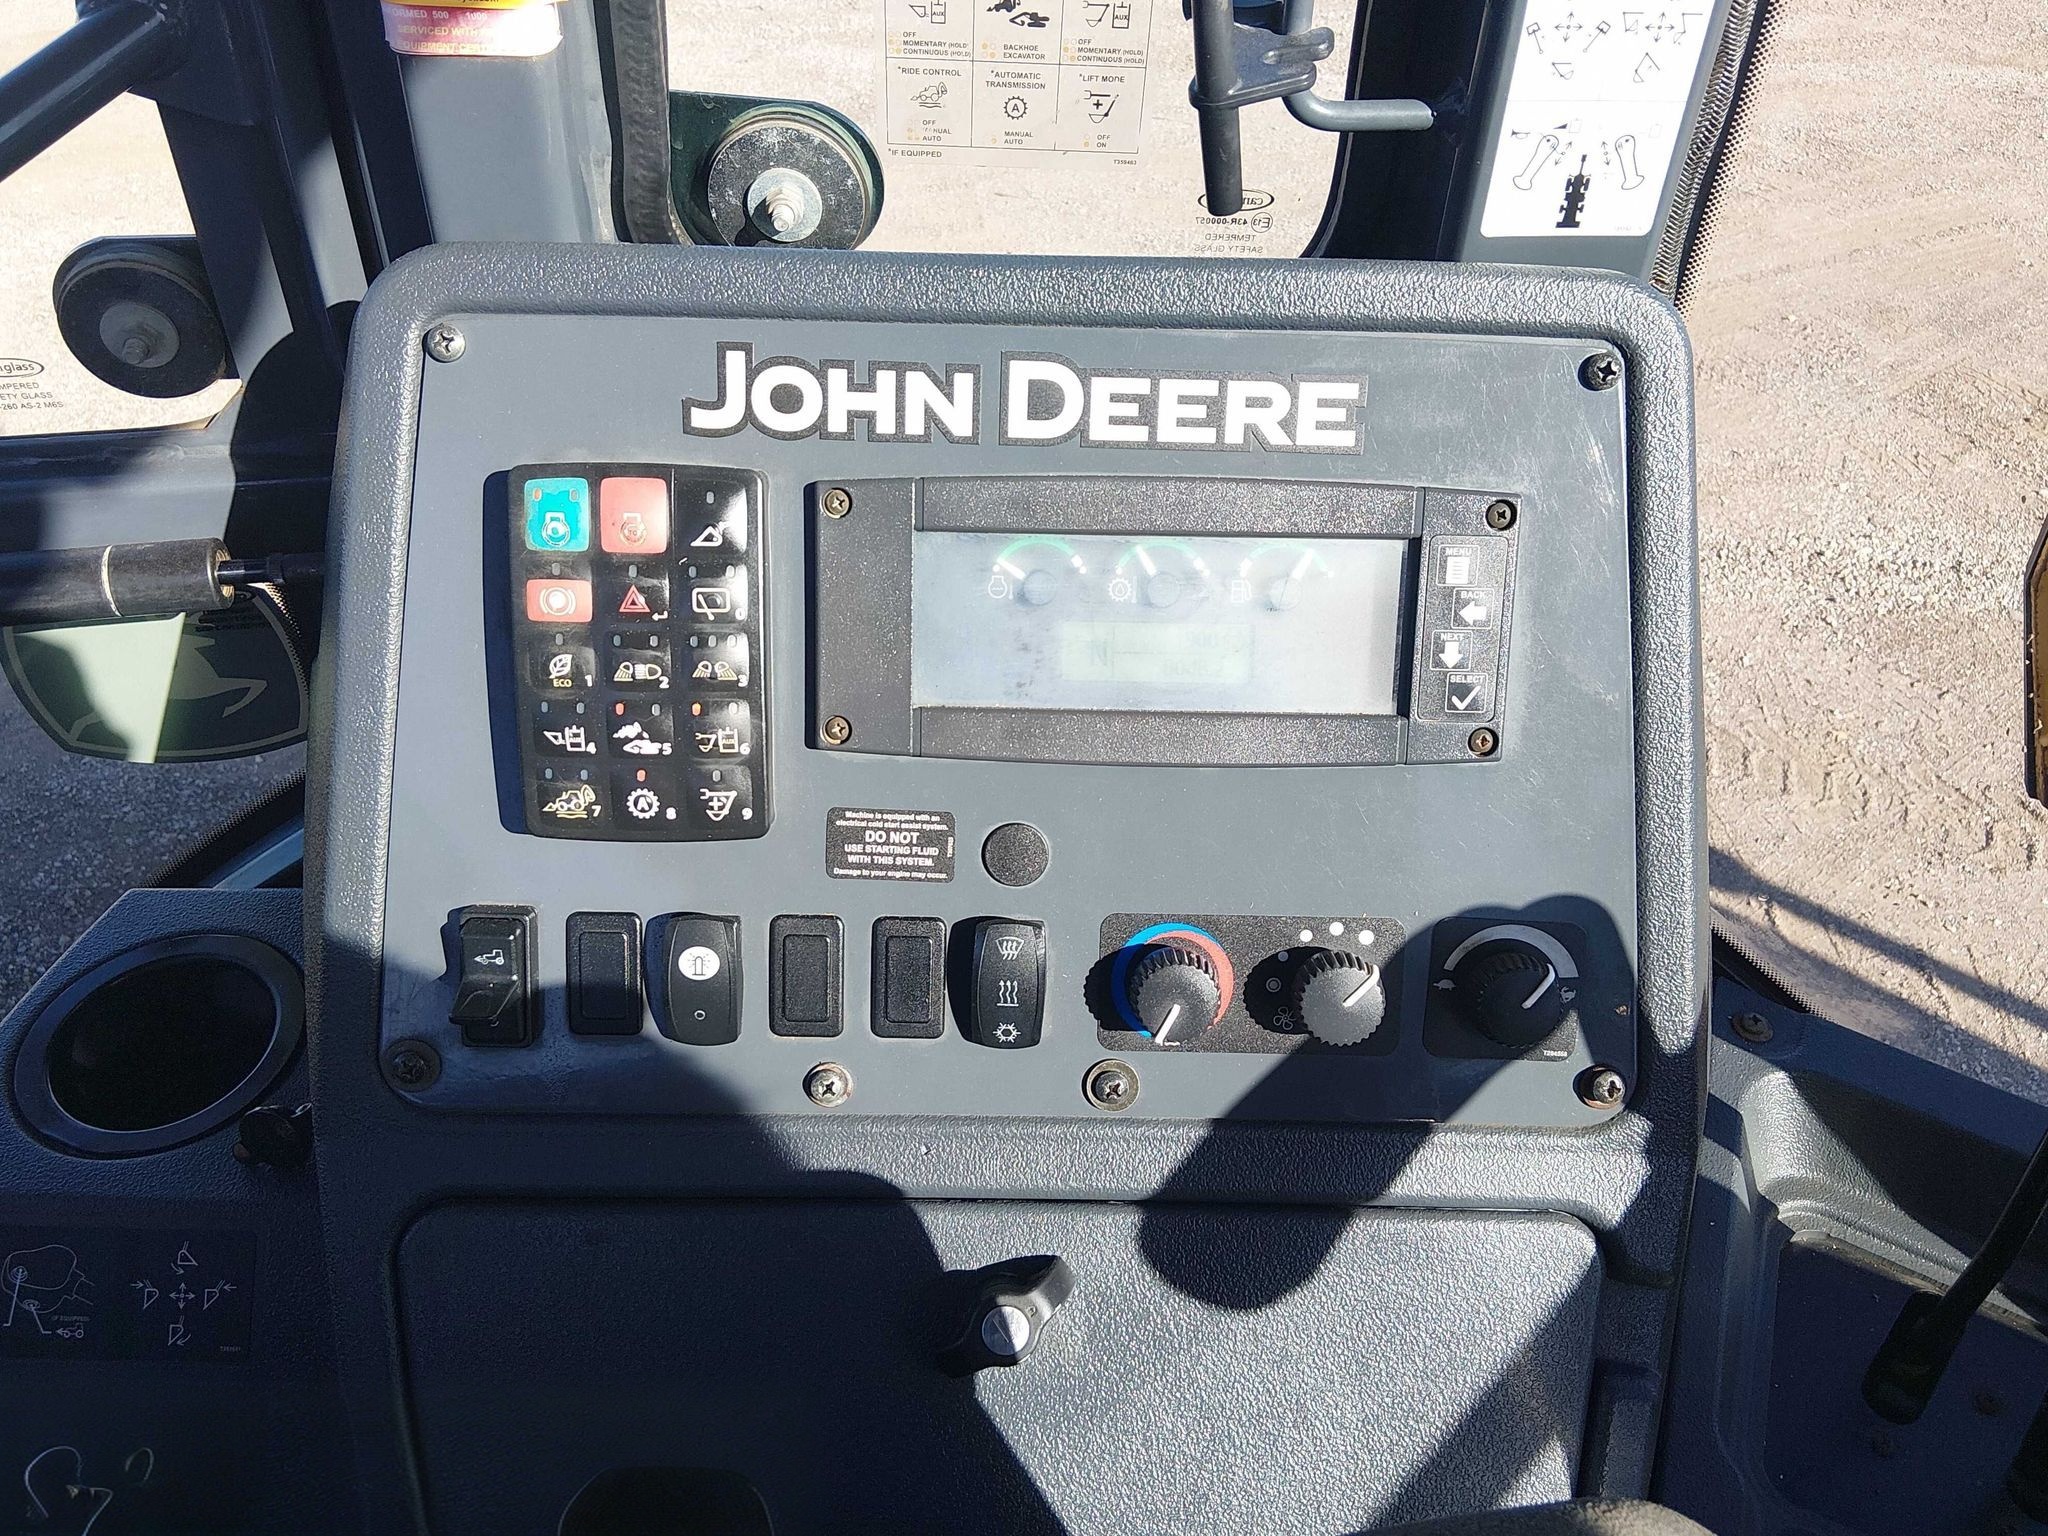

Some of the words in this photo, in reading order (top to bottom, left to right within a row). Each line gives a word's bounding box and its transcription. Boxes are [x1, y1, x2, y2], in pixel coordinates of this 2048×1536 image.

[432, 10, 449, 19] 500
[902, 40, 947, 48] MOMENTARY
[1003, 43, 1039, 52] BACKHOE
[903, 48, 949, 56] CONTINUOUS
[1003, 51, 1046, 60] EXCAVATOR
[1077, 47, 1121, 55] MOMENTARY
[1077, 55, 1123, 63] CONTINUOUS
[922, 68, 962, 77] CONTROL
[985, 80, 1046, 89] TRANSMISSION
[1004, 130, 1034, 138] MANUAL
[901, 149, 942, 158] EQUIPPED
[0, 382, 40, 390] MPERED
[21, 391, 53, 400] GLASS
[690, 350, 975, 437] JOHN
[1007, 359, 1359, 447] DEERE
[1445, 547, 1472, 556] MENU
[1460, 590, 1485, 599] BACK
[1440, 632, 1464, 641] NEXT
[552, 678, 573, 688] ECO
[584, 675, 593, 687] 1
[658, 676, 670, 689] 2
[738, 675, 748, 688] 3
[1450, 674, 1486, 683] SELECT
[586, 743, 597, 754] 4
[662, 743, 673, 755] 5
[740, 743, 750, 755] 6
[592, 805, 601, 817] 7
[666, 807, 676, 820] 8
[742, 808, 753, 820] 9
[845, 811, 874, 819] Machine
[883, 813, 914, 821] equipped
[836, 819, 867, 827] electrical
[868, 820, 883, 828] cold
[922, 823, 949, 831] system.
[865, 830, 887, 843] DO
[889, 831, 920, 844] NOT
[844, 843, 863, 853] USE
[865, 844, 911, 855] STARTING
[912, 846, 940, 856] FLUID
[847, 854, 871, 864] WITH
[872, 855, 894, 865] THIS
[895, 856, 935, 867] SYSTEM.
[833, 867, 861, 877] Damage
[862, 868, 870, 876] to
[870, 869, 887, 878] your
[887, 870, 911, 879] engine
[911, 871, 927, 879] may
